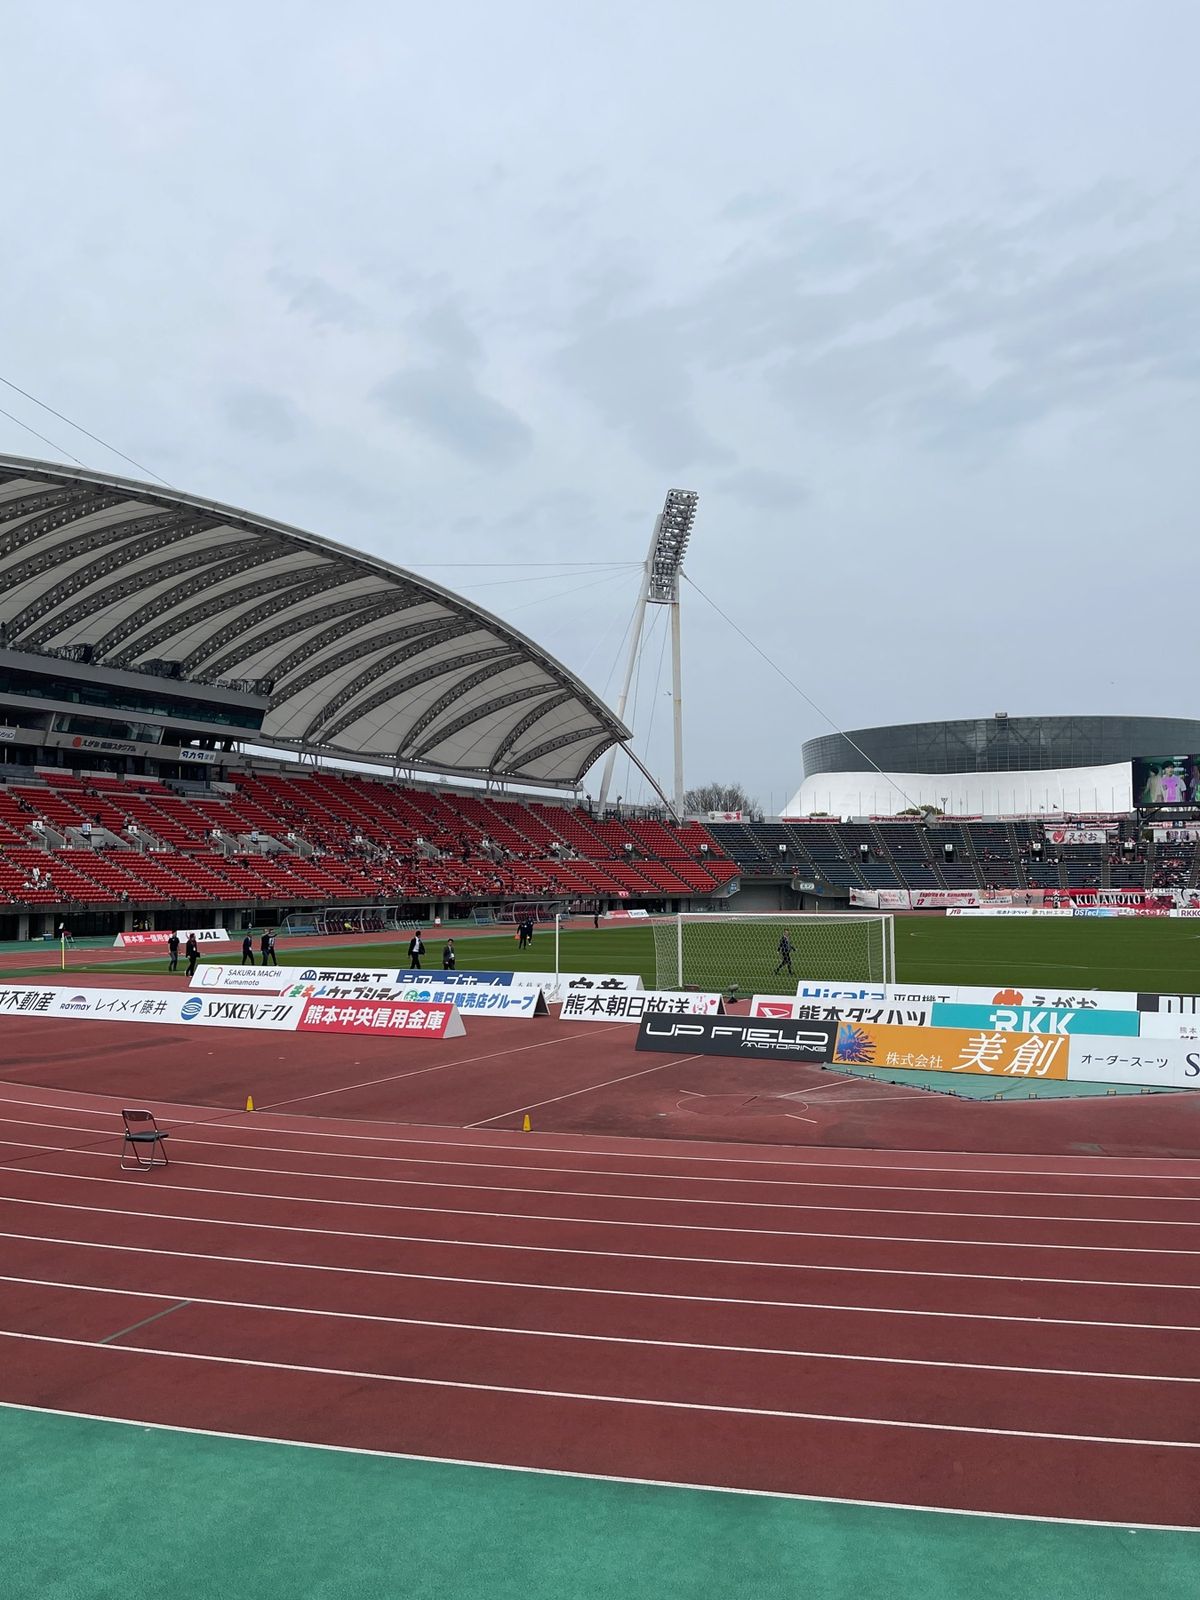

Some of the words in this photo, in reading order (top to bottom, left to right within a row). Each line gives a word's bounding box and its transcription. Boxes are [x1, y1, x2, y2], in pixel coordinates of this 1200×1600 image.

[1069, 831, 1097, 841] えがお
[1076, 894, 1141, 906] KUMAMOTO
[123, 933, 173, 944] 熊本第一信用金
[198, 931, 220, 941] JAL
[228, 969, 256, 977] SAKURA
[258, 970, 282, 978] MACHI
[224, 978, 260, 987] Kumamoto
[95, 999, 168, 1016] レイメイ藤井
[432, 991, 536, 1010] 熊日販売店グループ
[563, 993, 690, 1018] 熊本朝日放送
[303, 1005, 447, 1031] 熊本中央信用金庫
[990, 1010, 1076, 1036] RKK
[646, 1022, 705, 1037] UP
[711, 1026, 828, 1046] FIELD
[741, 1042, 827, 1053] MOTORING
[885, 1052, 944, 1070] 株式会社
[951, 1032, 1065, 1077] 美創
[1080, 1053, 1169, 1070] オーダースーツ
